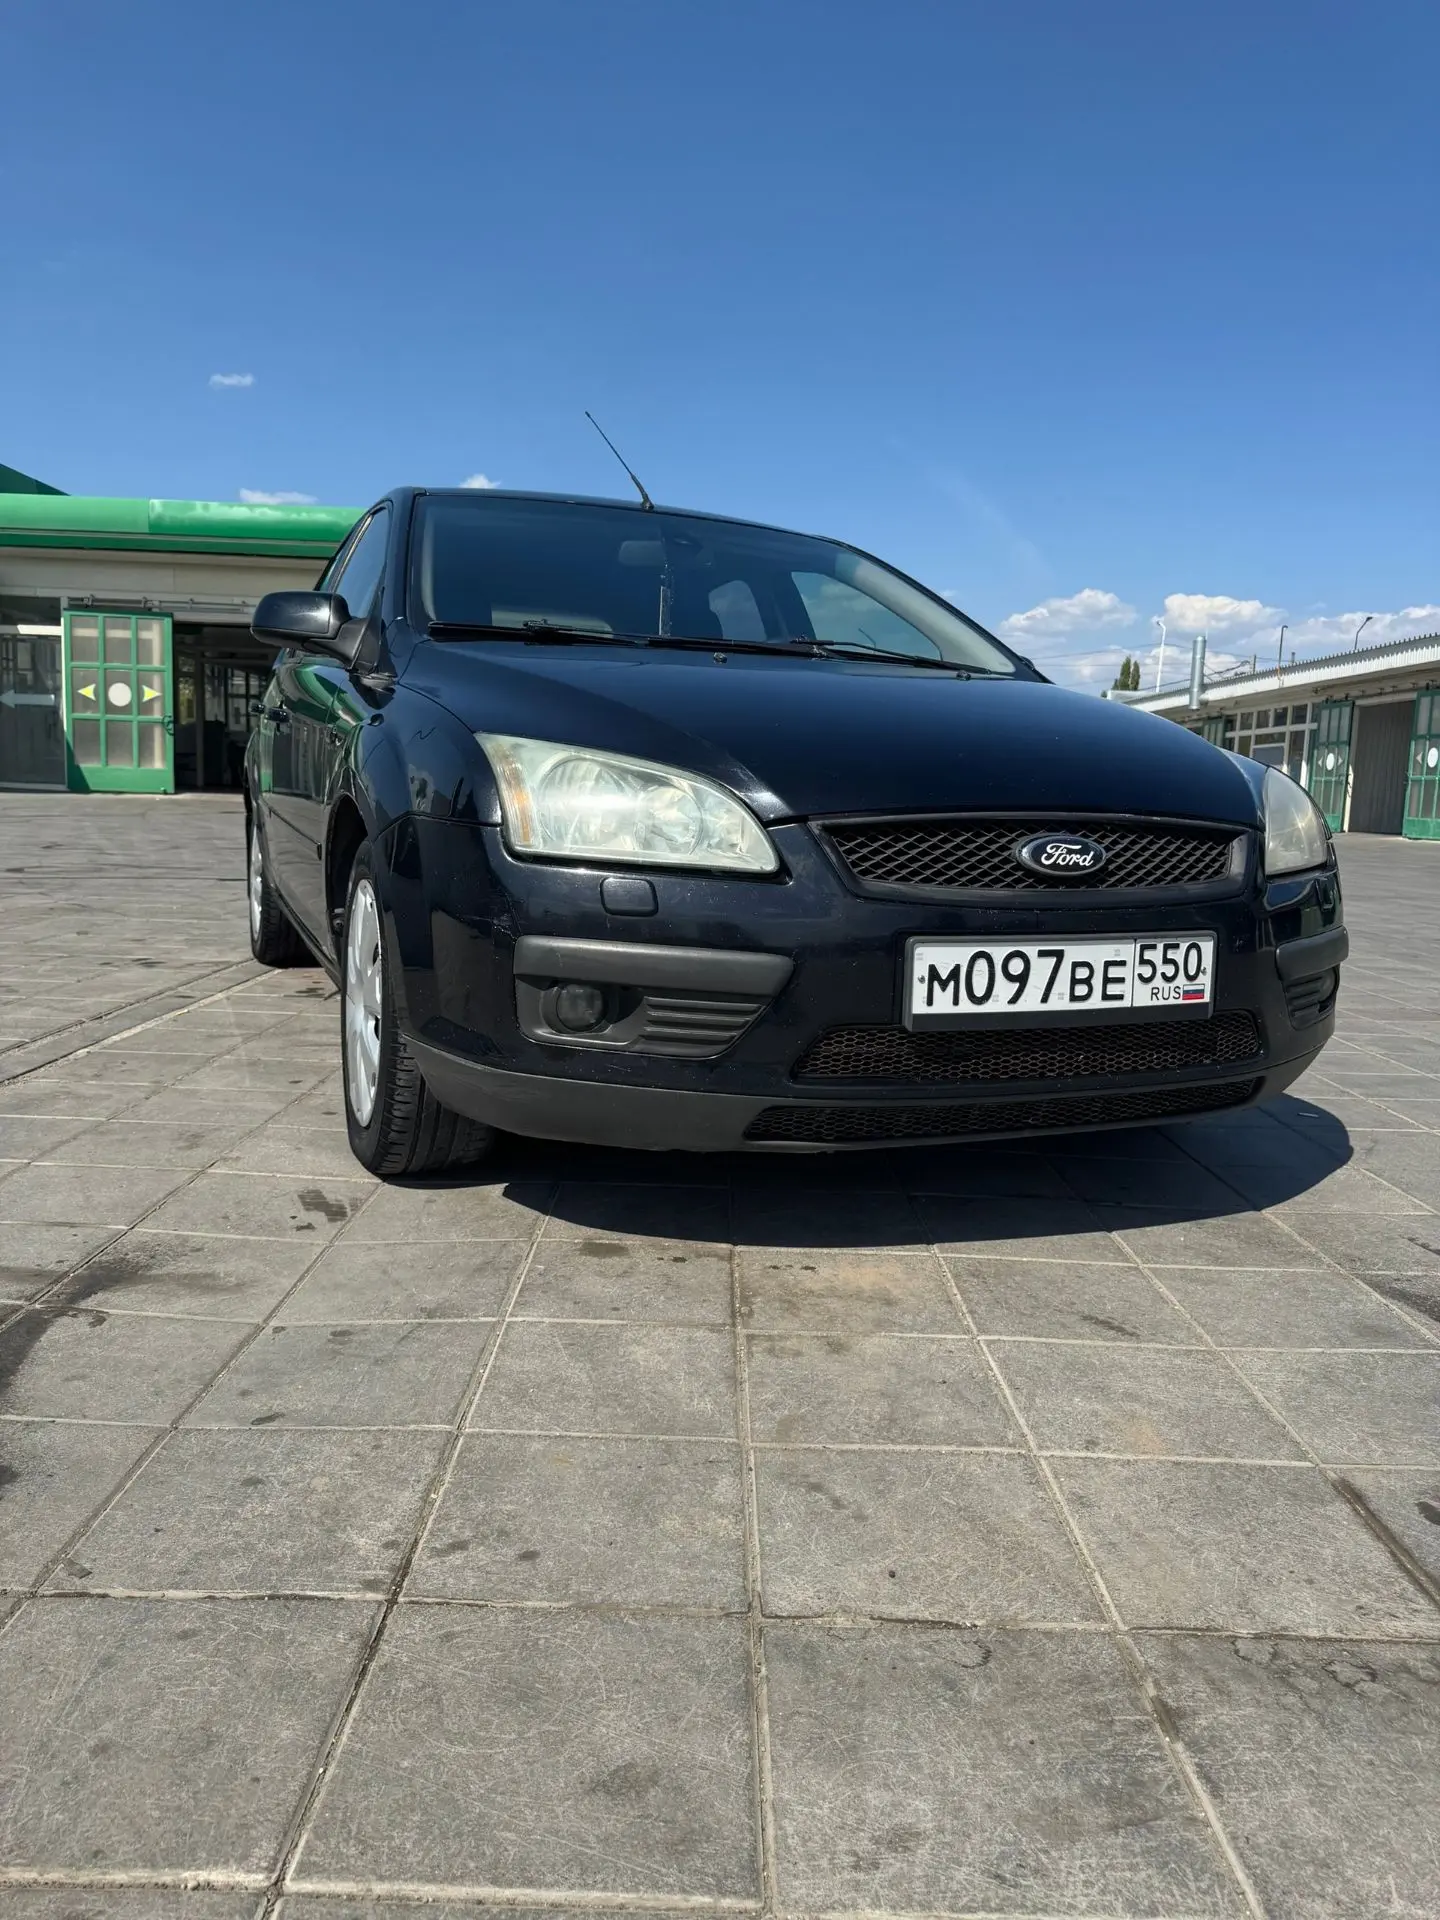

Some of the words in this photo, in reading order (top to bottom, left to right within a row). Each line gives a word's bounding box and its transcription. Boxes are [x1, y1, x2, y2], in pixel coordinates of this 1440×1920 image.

[1041, 843, 1094, 866] Ford
[1137, 942, 1202, 983] 550
[1150, 986, 1181, 1001] RUS
